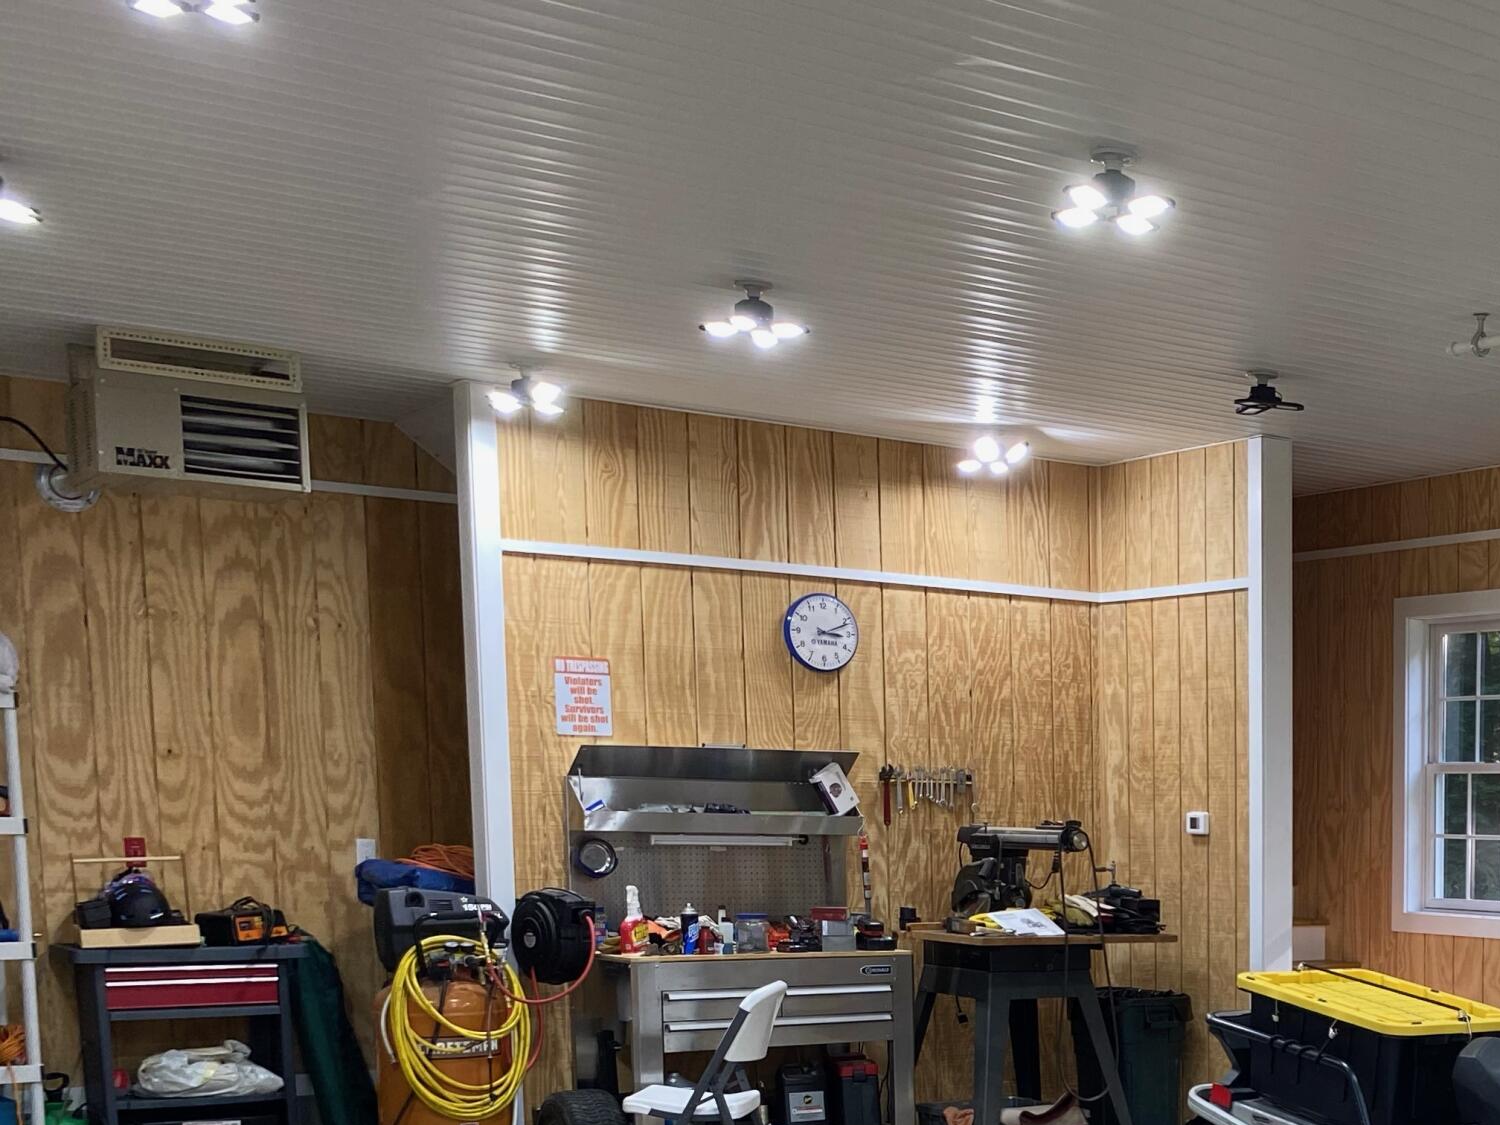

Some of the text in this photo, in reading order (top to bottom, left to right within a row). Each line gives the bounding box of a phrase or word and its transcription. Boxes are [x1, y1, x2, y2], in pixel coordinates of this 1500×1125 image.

[115, 446, 171, 469] MAXX
[807, 604, 815, 612] 11
[820, 602, 827, 610] 12
[799, 614, 808, 622] 10
[564, 676, 603, 686] Violators
[570, 687, 598, 695] will be
[564, 704, 604, 714] Survivors
[560, 714, 608, 724] will be shot
